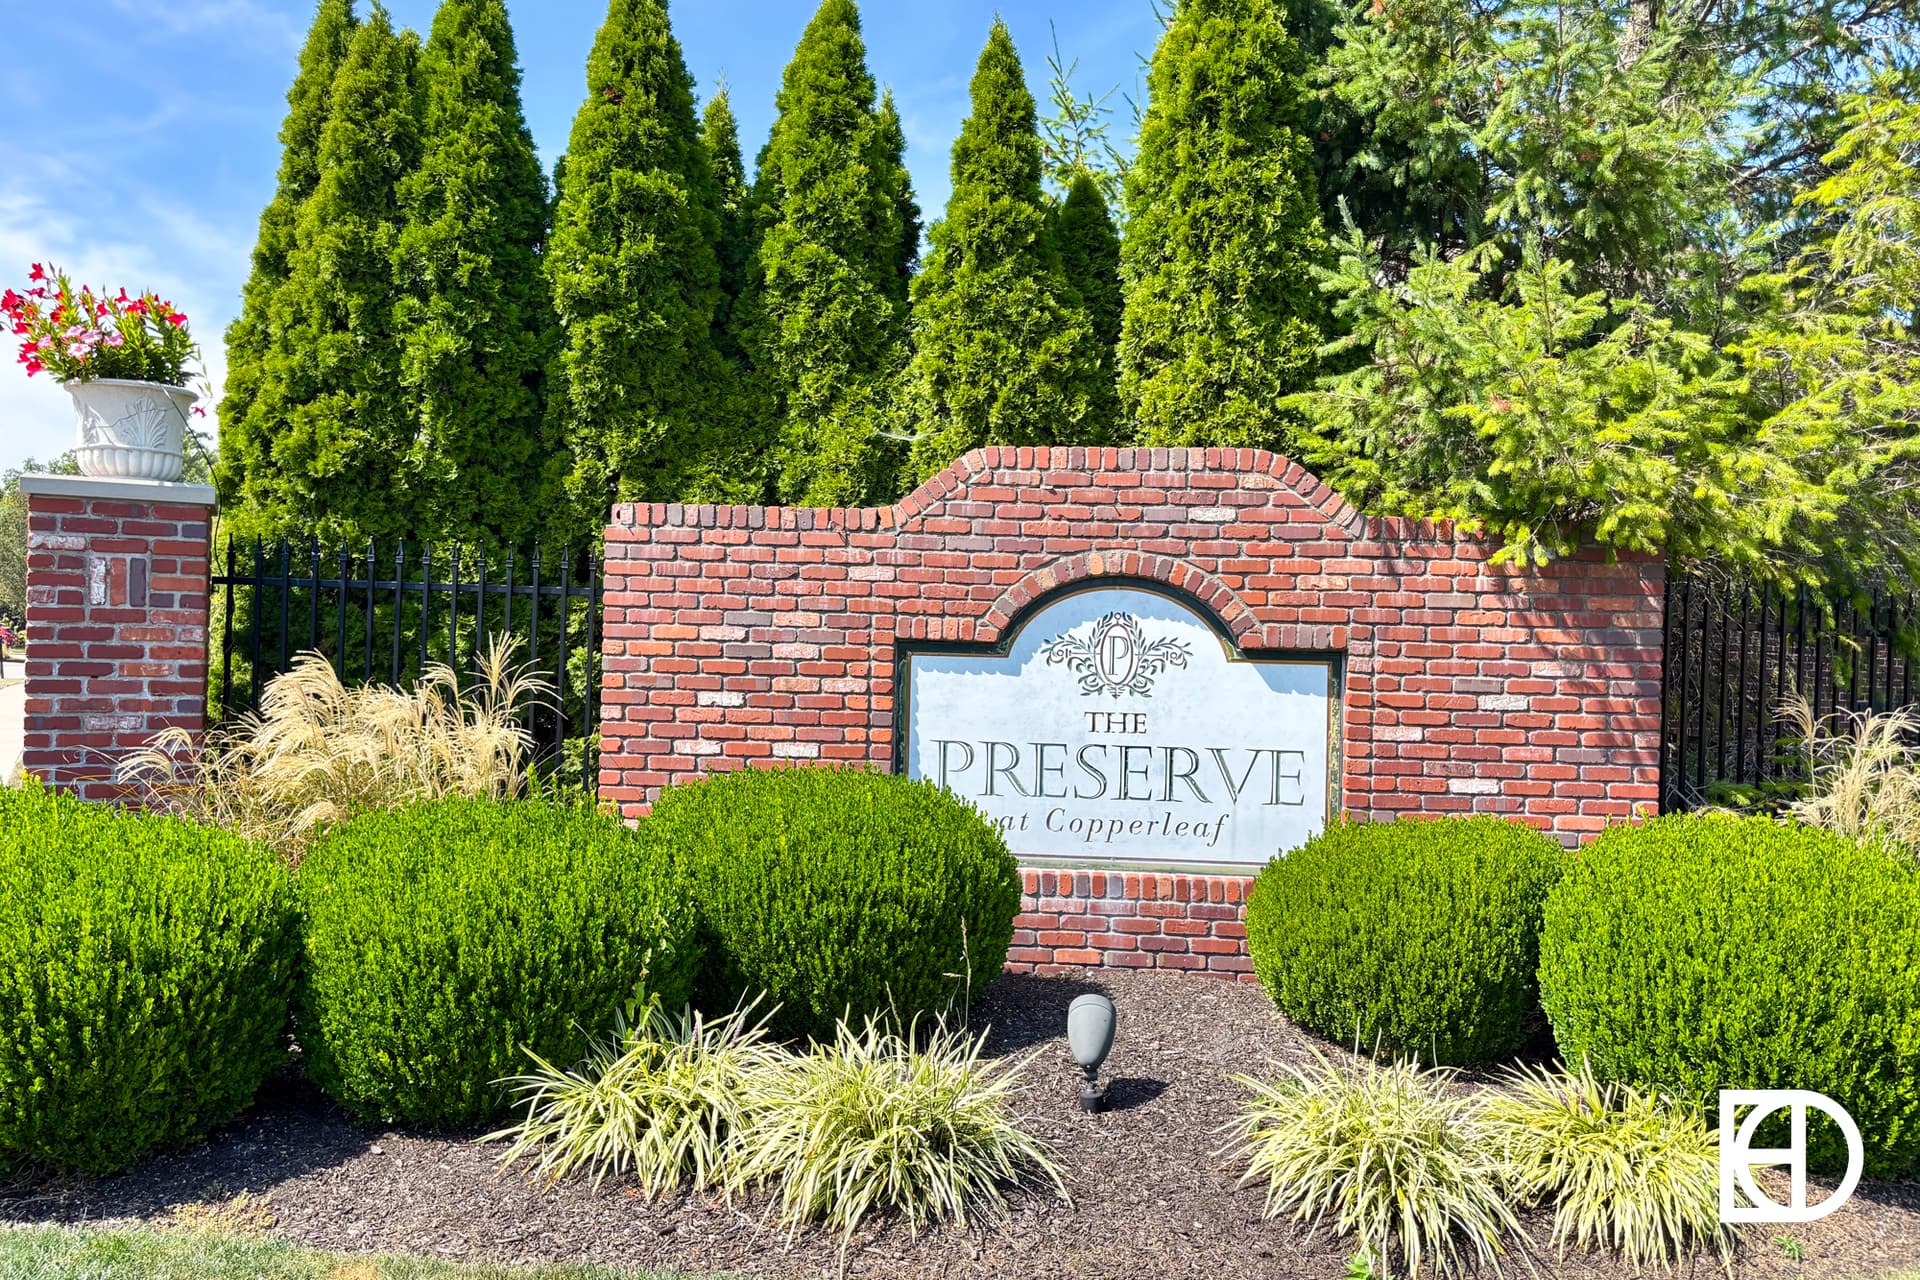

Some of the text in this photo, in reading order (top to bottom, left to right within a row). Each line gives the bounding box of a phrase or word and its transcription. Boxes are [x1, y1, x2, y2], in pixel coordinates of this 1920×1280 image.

[1106, 635, 1129, 676] P
[1083, 711, 1147, 734] THE
[930, 739, 1305, 806] PRESERVE
[999, 807, 1229, 847] at Copperleaf
